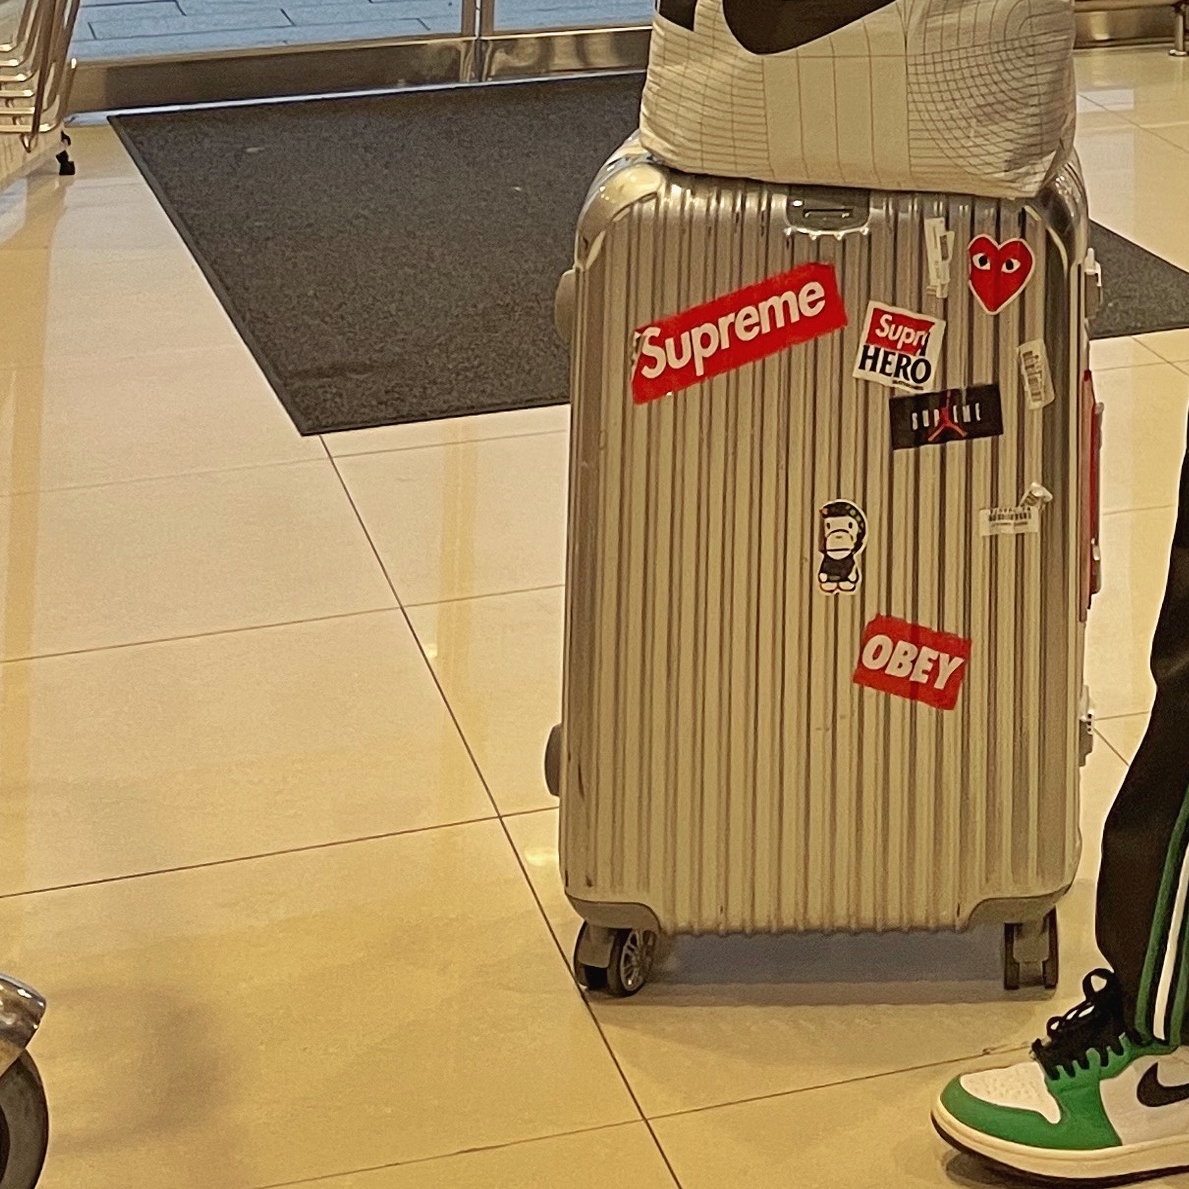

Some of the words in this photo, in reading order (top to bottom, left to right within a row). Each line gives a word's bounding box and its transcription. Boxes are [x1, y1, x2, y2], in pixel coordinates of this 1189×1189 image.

[640, 281, 826, 379] Supreme
[858, 345, 932, 384] HERO
[862, 634, 965, 690] OBEY
